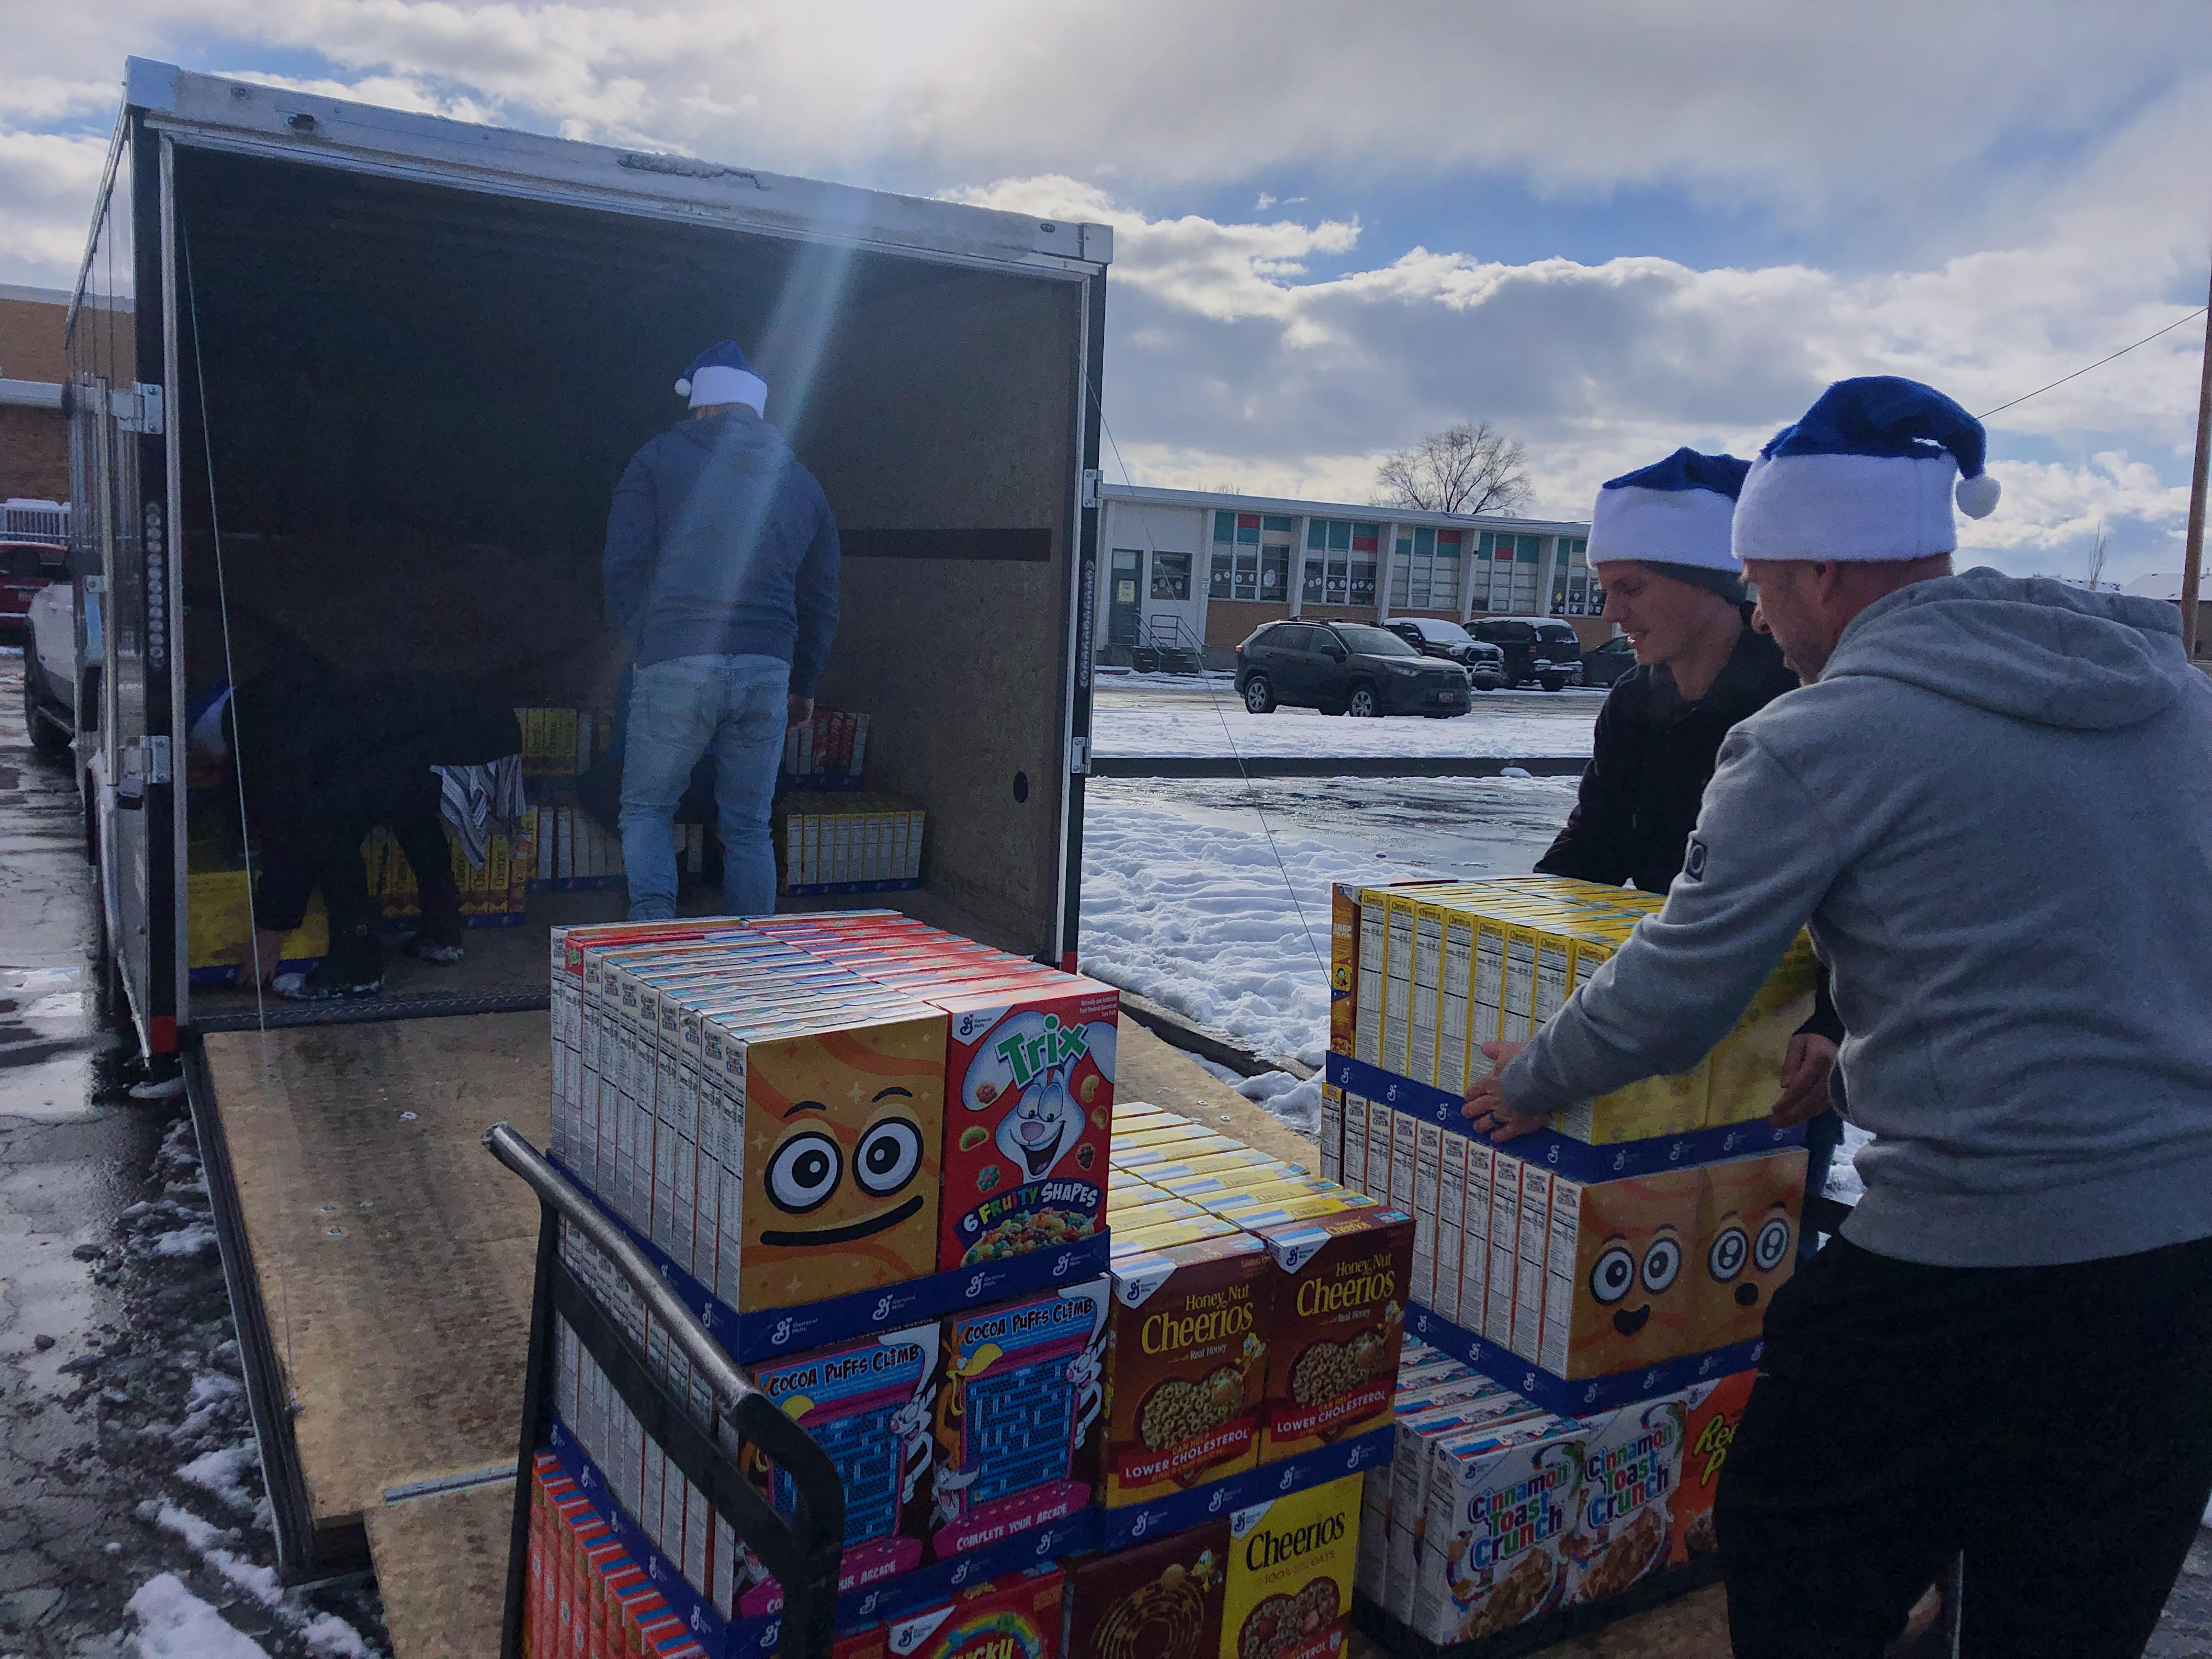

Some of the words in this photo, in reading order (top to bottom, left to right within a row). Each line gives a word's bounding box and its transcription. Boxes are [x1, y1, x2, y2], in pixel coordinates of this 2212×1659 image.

[1364, 895, 1384, 906] Cheerios
[1391, 901, 1412, 912] Cheerios
[1419, 908, 1441, 920] Cheerios
[1449, 915, 1471, 927] Cheerios
[1480, 922, 1502, 936] Cheerios
[996, 1014, 1088, 1087] Trix
[964, 1214, 978, 1232] 6
[978, 1186, 1039, 1225] FRUITY
[1041, 1182, 1098, 1207] SHAPES
[1326, 1221, 1372, 1235] Cheerios
[1336, 1260, 1371, 1277] Honey
[1373, 1252, 1392, 1268] Nut
[1186, 1291, 1224, 1311] Honey
[1228, 1283, 1250, 1302] Nut
[1297, 1270, 1395, 1317] Cheerios
[965, 1319, 1006, 1344] COCOA
[1053, 1299, 1092, 1323] CLIMB
[1142, 1302, 1254, 1355] Cheerios
[769, 1368, 817, 1397] COCOA
[872, 1345, 919, 1372] CLIMB
[1190, 1348, 1205, 1361] Real
[1206, 1343, 1227, 1356] Honey
[1277, 1416, 1316, 1433] LOWER
[1318, 1391, 1386, 1422] CHOLESTEROL
[1125, 1459, 1170, 1479] LOWER
[1172, 1429, 1249, 1466] CHOLESTEROL
[1589, 1425, 1673, 1477] Cinnamon
[1605, 1449, 1658, 1495] Toast
[1472, 1465, 1567, 1520] Cinnamon
[1491, 1491, 1550, 1537] Toast
[1592, 1464, 1669, 1525] Crunch
[957, 1528, 1005, 1551] COMPLETE
[1009, 1515, 1031, 1533] YOUR
[1036, 1502, 1067, 1525] ARCADE
[1246, 1512, 1345, 1572] Cheerios
[1474, 1505, 1563, 1567] Crunch
[860, 1560, 895, 1584] ARCADE
[1265, 1568, 1291, 1584] 100%
[1311, 1550, 1335, 1567] OATS
